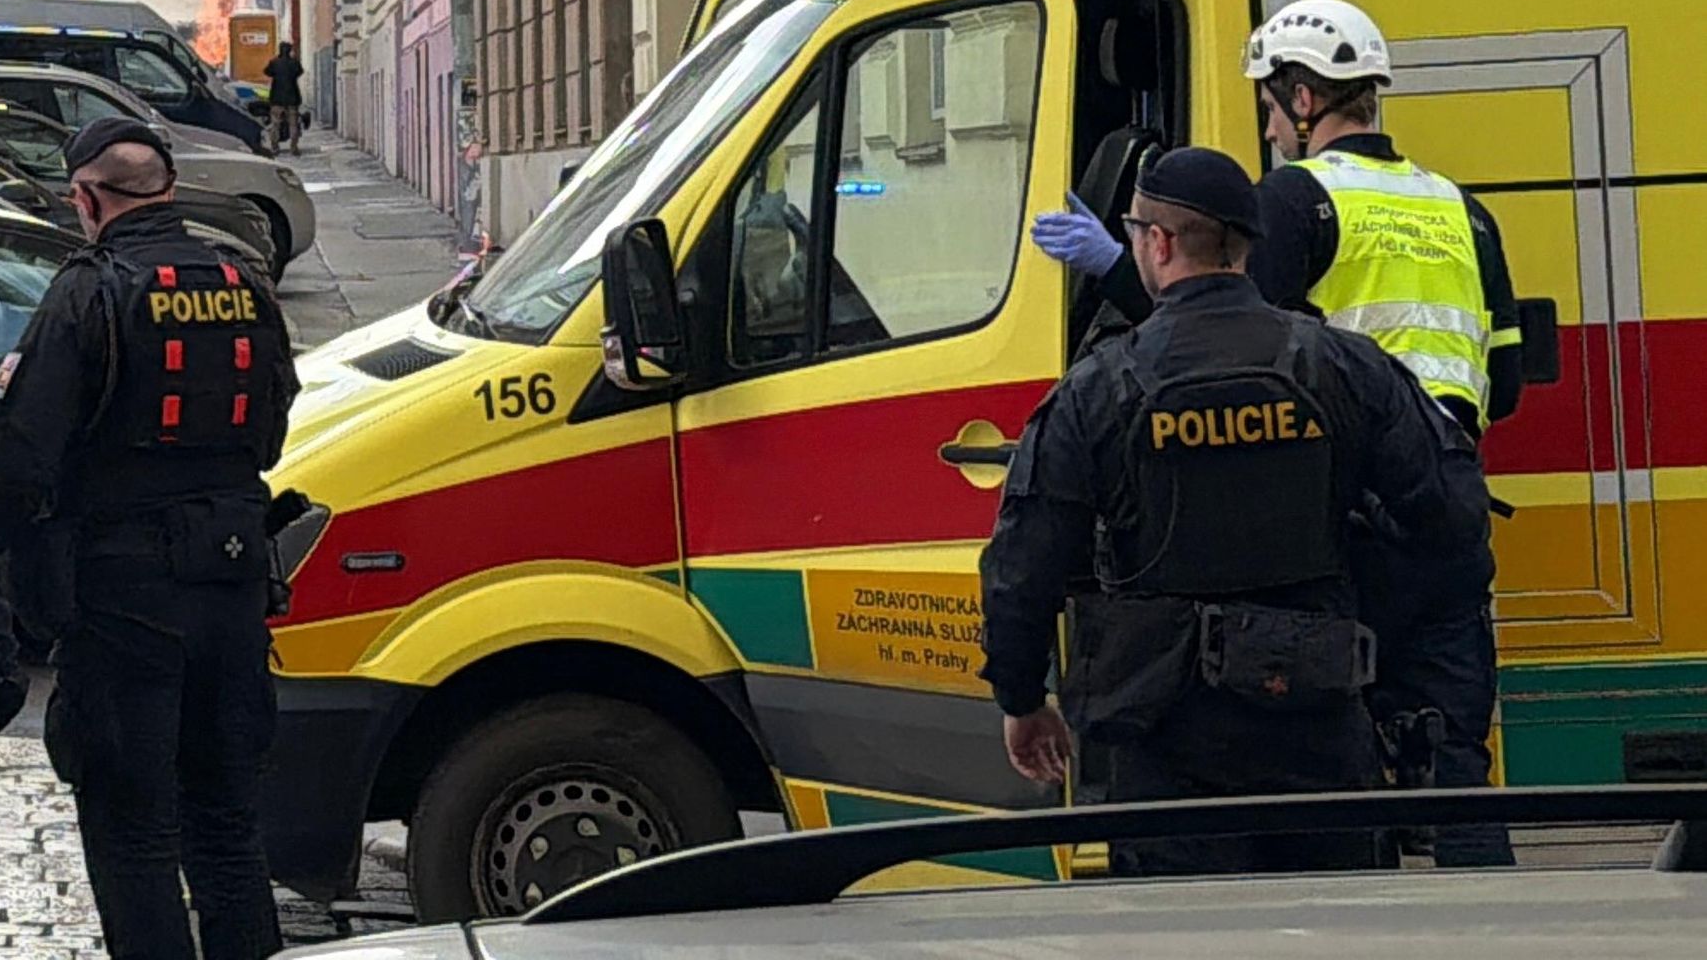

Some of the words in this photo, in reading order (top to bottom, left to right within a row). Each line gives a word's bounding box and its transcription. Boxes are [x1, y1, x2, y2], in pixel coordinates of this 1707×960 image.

[149, 288, 257, 324] POLICIE
[473, 372, 557, 421] 156
[1150, 400, 1298, 450] POLICIE
[854, 588, 981, 616] ZDRAVOTNICKÁ
[836, 606, 937, 639] ZÁCHRANNÁ
[939, 620, 982, 644] SLUŽ
[878, 643, 896, 662] hl.
[901, 649, 921, 665] m.
[923, 647, 970, 673] Prahy
